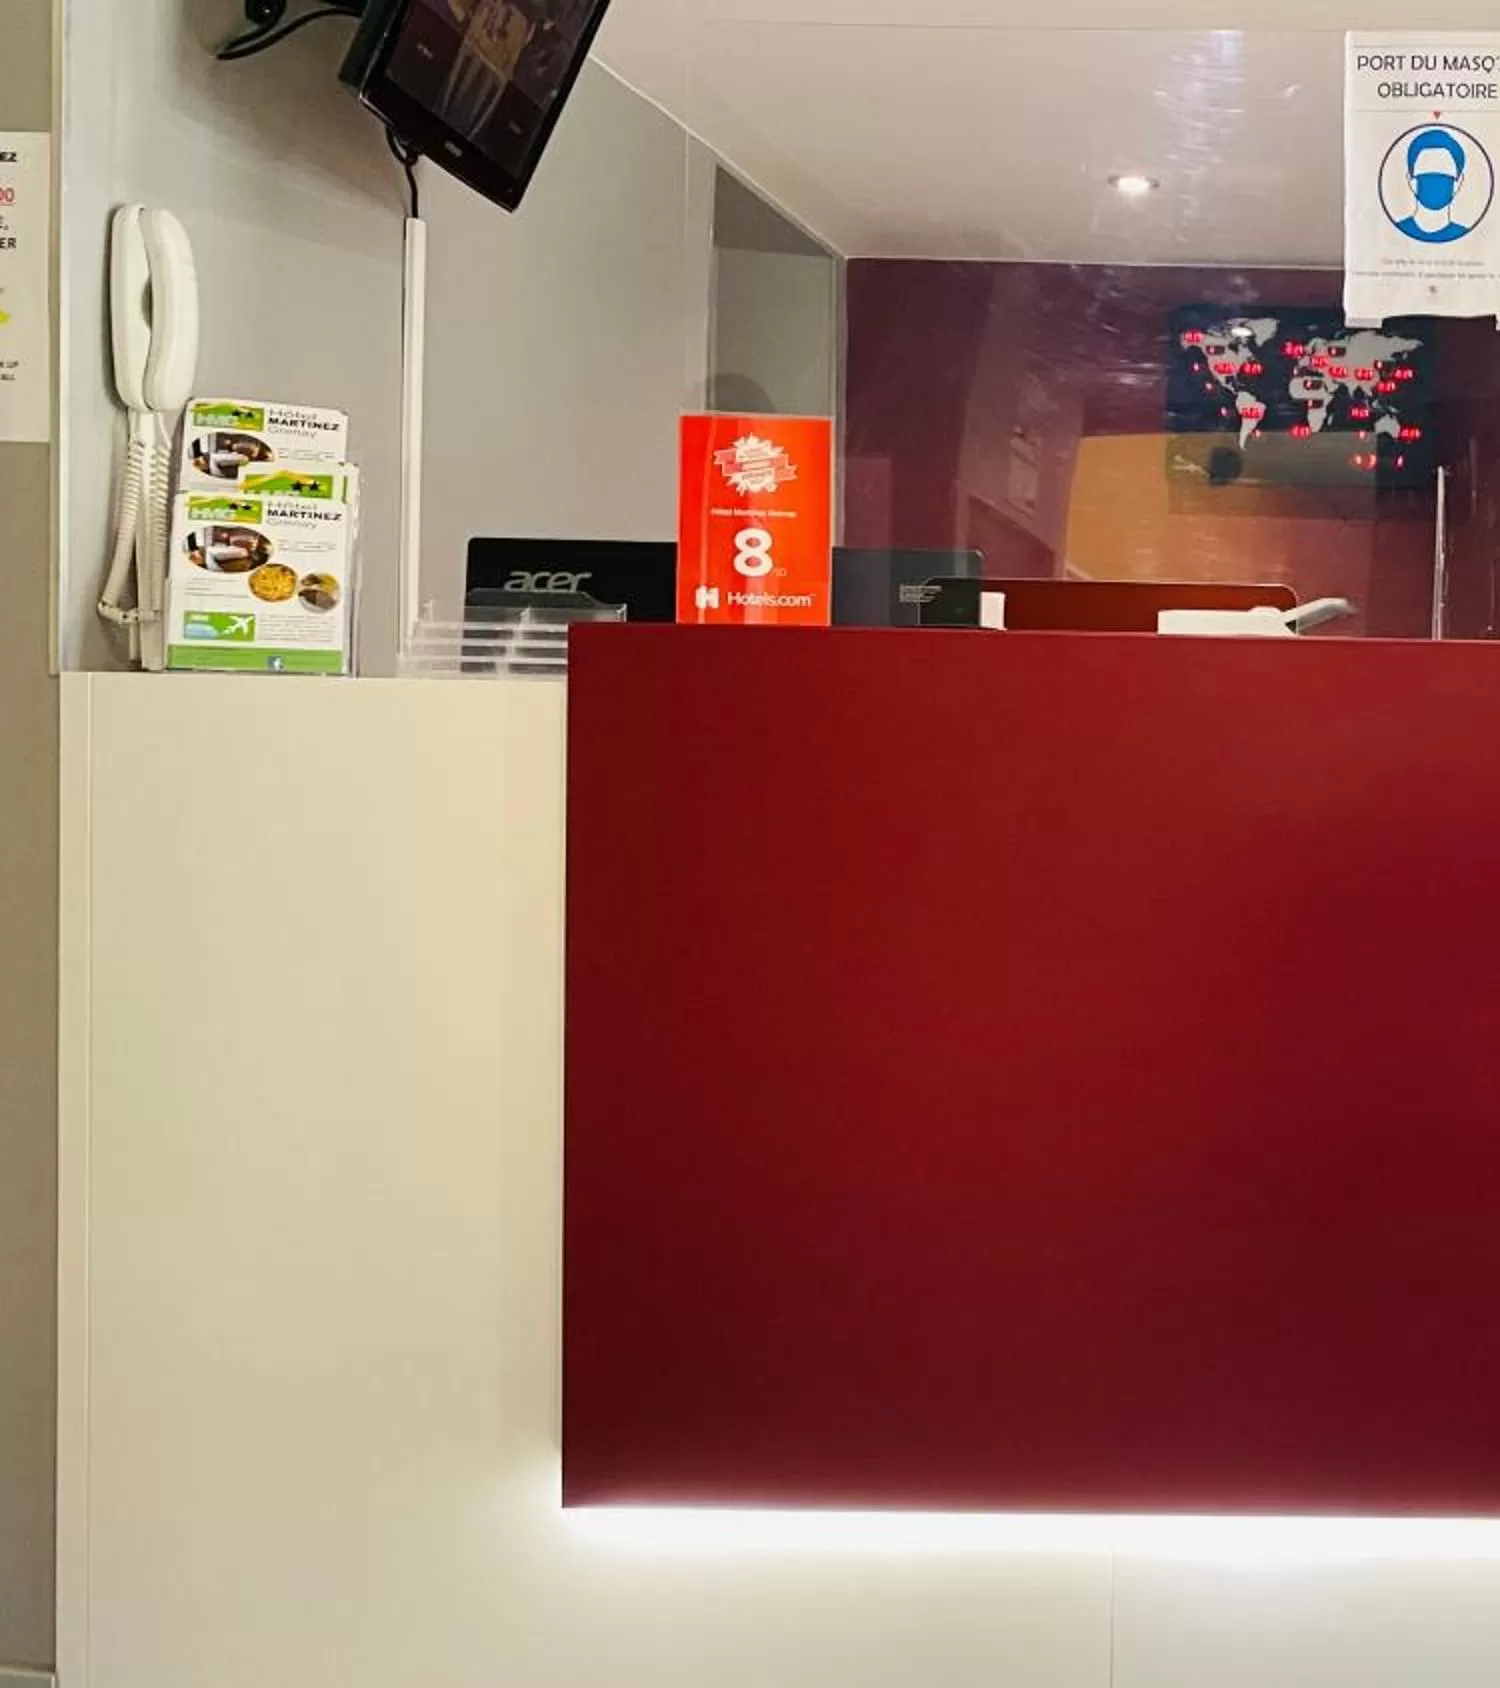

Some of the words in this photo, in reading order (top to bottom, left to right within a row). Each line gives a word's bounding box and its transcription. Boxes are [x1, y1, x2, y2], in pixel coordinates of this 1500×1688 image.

[1357, 55, 1406, 71] PORT
[1411, 55, 1438, 71] DU
[1377, 82, 1498, 98] OBLIGATOIRE
[268, 417, 340, 431] MARTINEZ
[267, 508, 342, 521] MARTINEZ
[733, 527, 773, 577] 8
[504, 571, 592, 592] acer
[727, 592, 812, 607] Hotels.com
